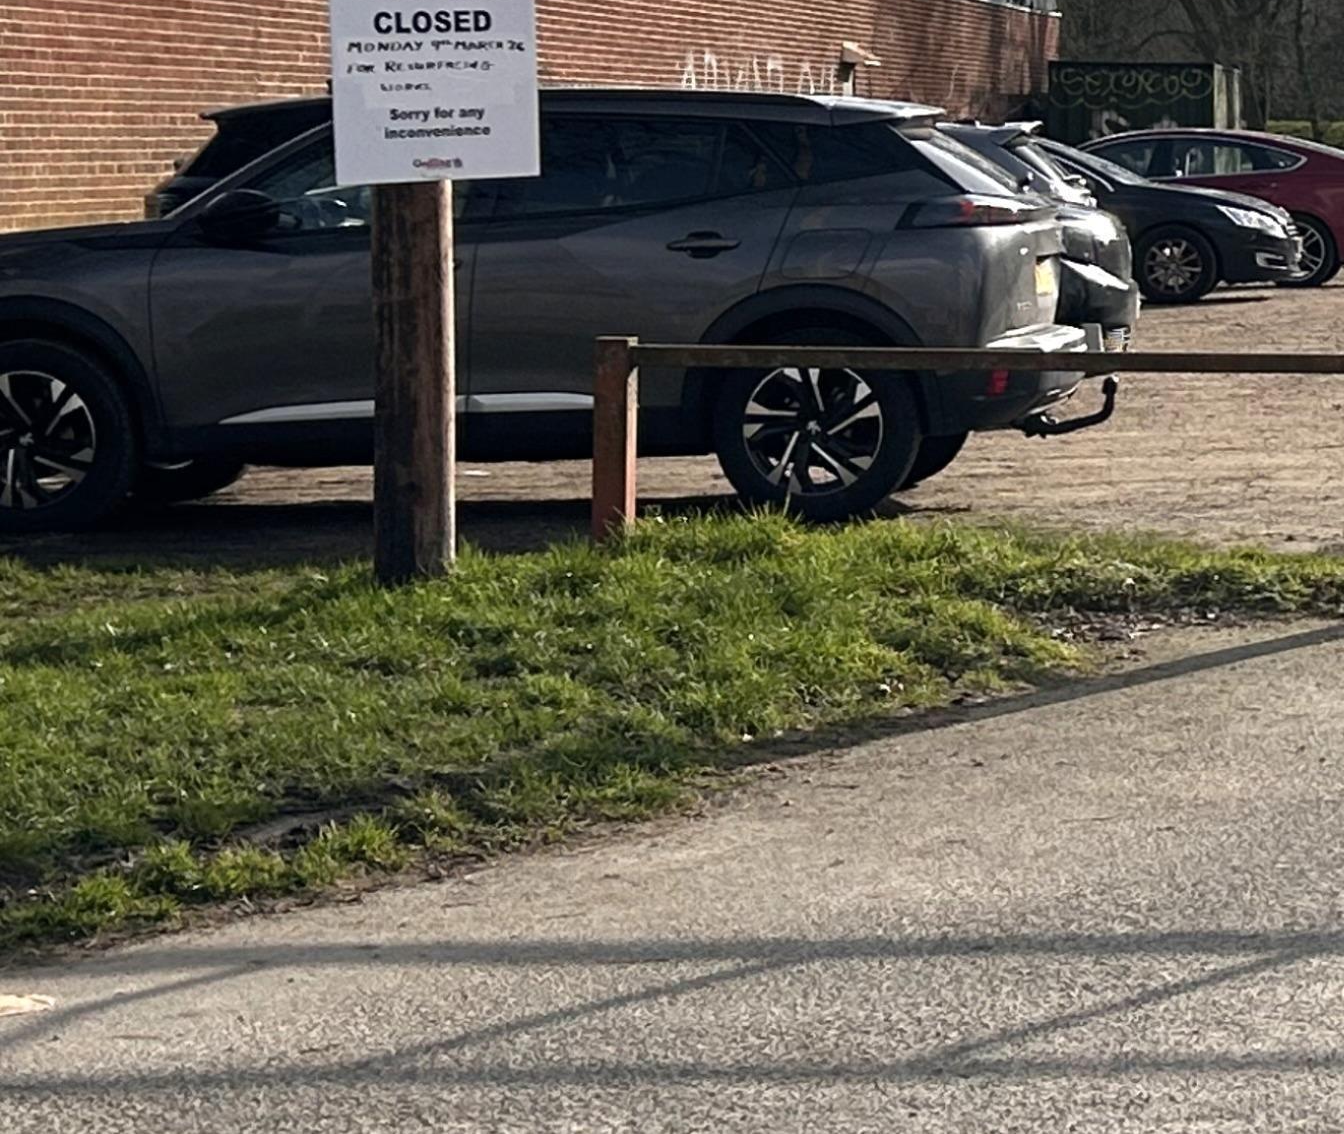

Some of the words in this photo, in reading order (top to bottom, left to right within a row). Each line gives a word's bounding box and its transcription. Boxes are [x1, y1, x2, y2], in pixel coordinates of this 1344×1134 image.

[374, 10, 492, 34] CLOSED
[347, 40, 423, 54] MONDAY
[454, 41, 503, 51] MARCH
[346, 62, 376, 74] FOR
[389, 108, 430, 122] Sorry
[434, 107, 454, 119] for
[459, 108, 485, 120] any
[384, 125, 491, 139] inconvenience
